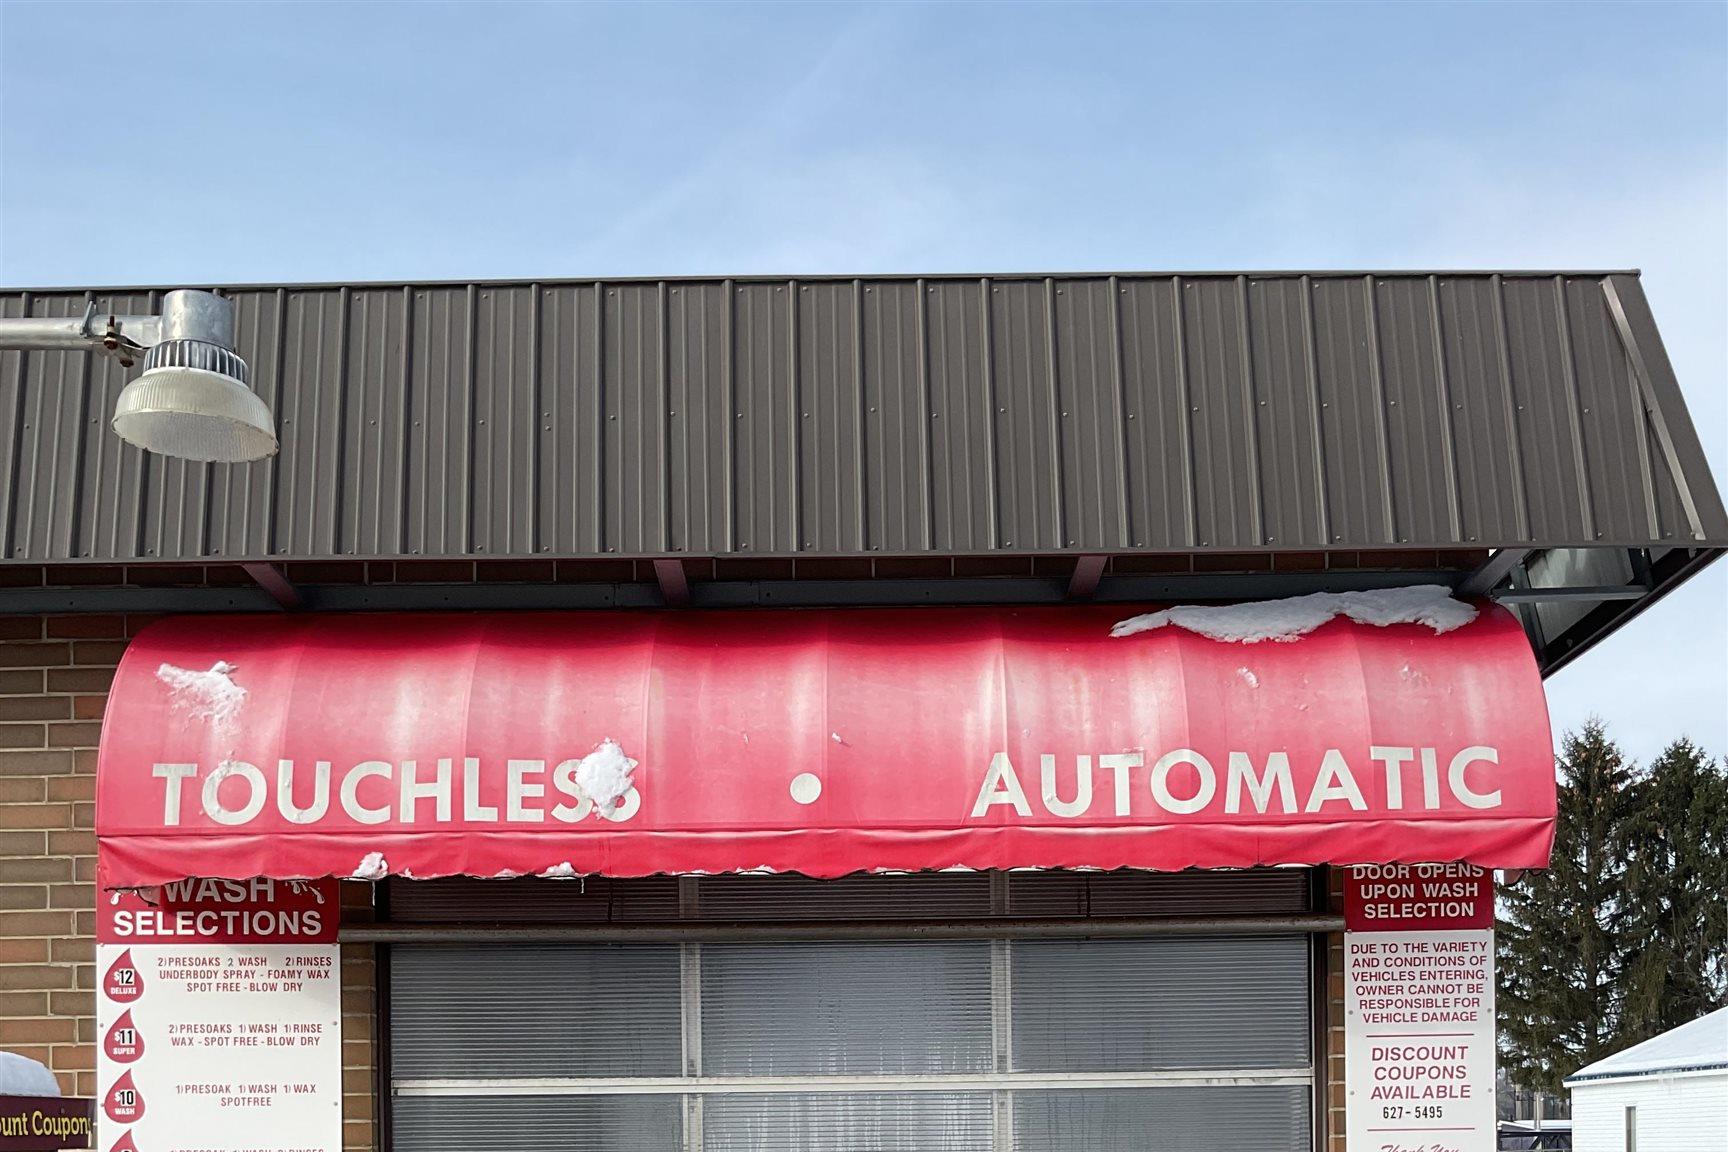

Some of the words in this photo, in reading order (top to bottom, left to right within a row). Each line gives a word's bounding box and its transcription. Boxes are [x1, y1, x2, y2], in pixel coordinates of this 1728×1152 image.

[971, 746, 1502, 818] AUTOMATIC
[1353, 865, 1410, 880] DOOR
[1417, 863, 1484, 879] OPENS
[165, 878, 275, 903] WASH
[1360, 884, 1415, 899] UPON
[1422, 882, 1478, 898] WASH
[1364, 902, 1474, 919] SELECTION
[113, 910, 322, 936] SELECTIONS
[1351, 944, 1377, 955] DUE
[1381, 943, 1399, 954] TO
[1403, 943, 1429, 953] THE
[1432, 941, 1487, 953] VARIETY
[238, 957, 267, 966] WASH
[1352, 957, 1380, 968] AND
[1384, 956, 1465, 968] CONDITIONS
[1469, 955, 1487, 966] OF
[159, 970, 219, 979] UNDERBODY
[223, 970, 256, 979] SPRAY
[267, 970, 303, 979] FOAMY
[307, 969, 330, 979] WAX
[1352, 971, 1416, 982] VEHICLES
[1420, 969, 1488, 981] ENTERING,
[110, 987, 137, 995] DELUXE
[187, 982, 212, 992] SPOT
[216, 982, 241, 992] FREE
[283, 982, 303, 992] DRY
[1356, 985, 1404, 996] OWNER
[1408, 984, 1463, 995] CANNOT
[1467, 983, 1484, 994] BE
[1360, 998, 1450, 1010] RESPONSIBLE
[1454, 997, 1480, 1008] FOR
[1363, 1012, 1418, 1023] VEHICLE
[1421, 1011, 1478, 1023] DAMAGE
[171, 1036, 194, 1046] WAX
[204, 1036, 229, 1046] SPOT
[233, 1036, 258, 1046] FREE
[267, 1036, 295, 1046] BLOW
[300, 1036, 320, 1046] DRY
[113, 1047, 136, 1055] SUPER
[1372, 1046, 1469, 1061] DISCOUNT
[1374, 1065, 1467, 1081] COUPONS
[1370, 1085, 1471, 1100] AVAILABLE
[221, 1097, 272, 1107] SPOTFREE
[115, 1107, 135, 1115] WASH
[0, 1112, 29, 1136] unt
